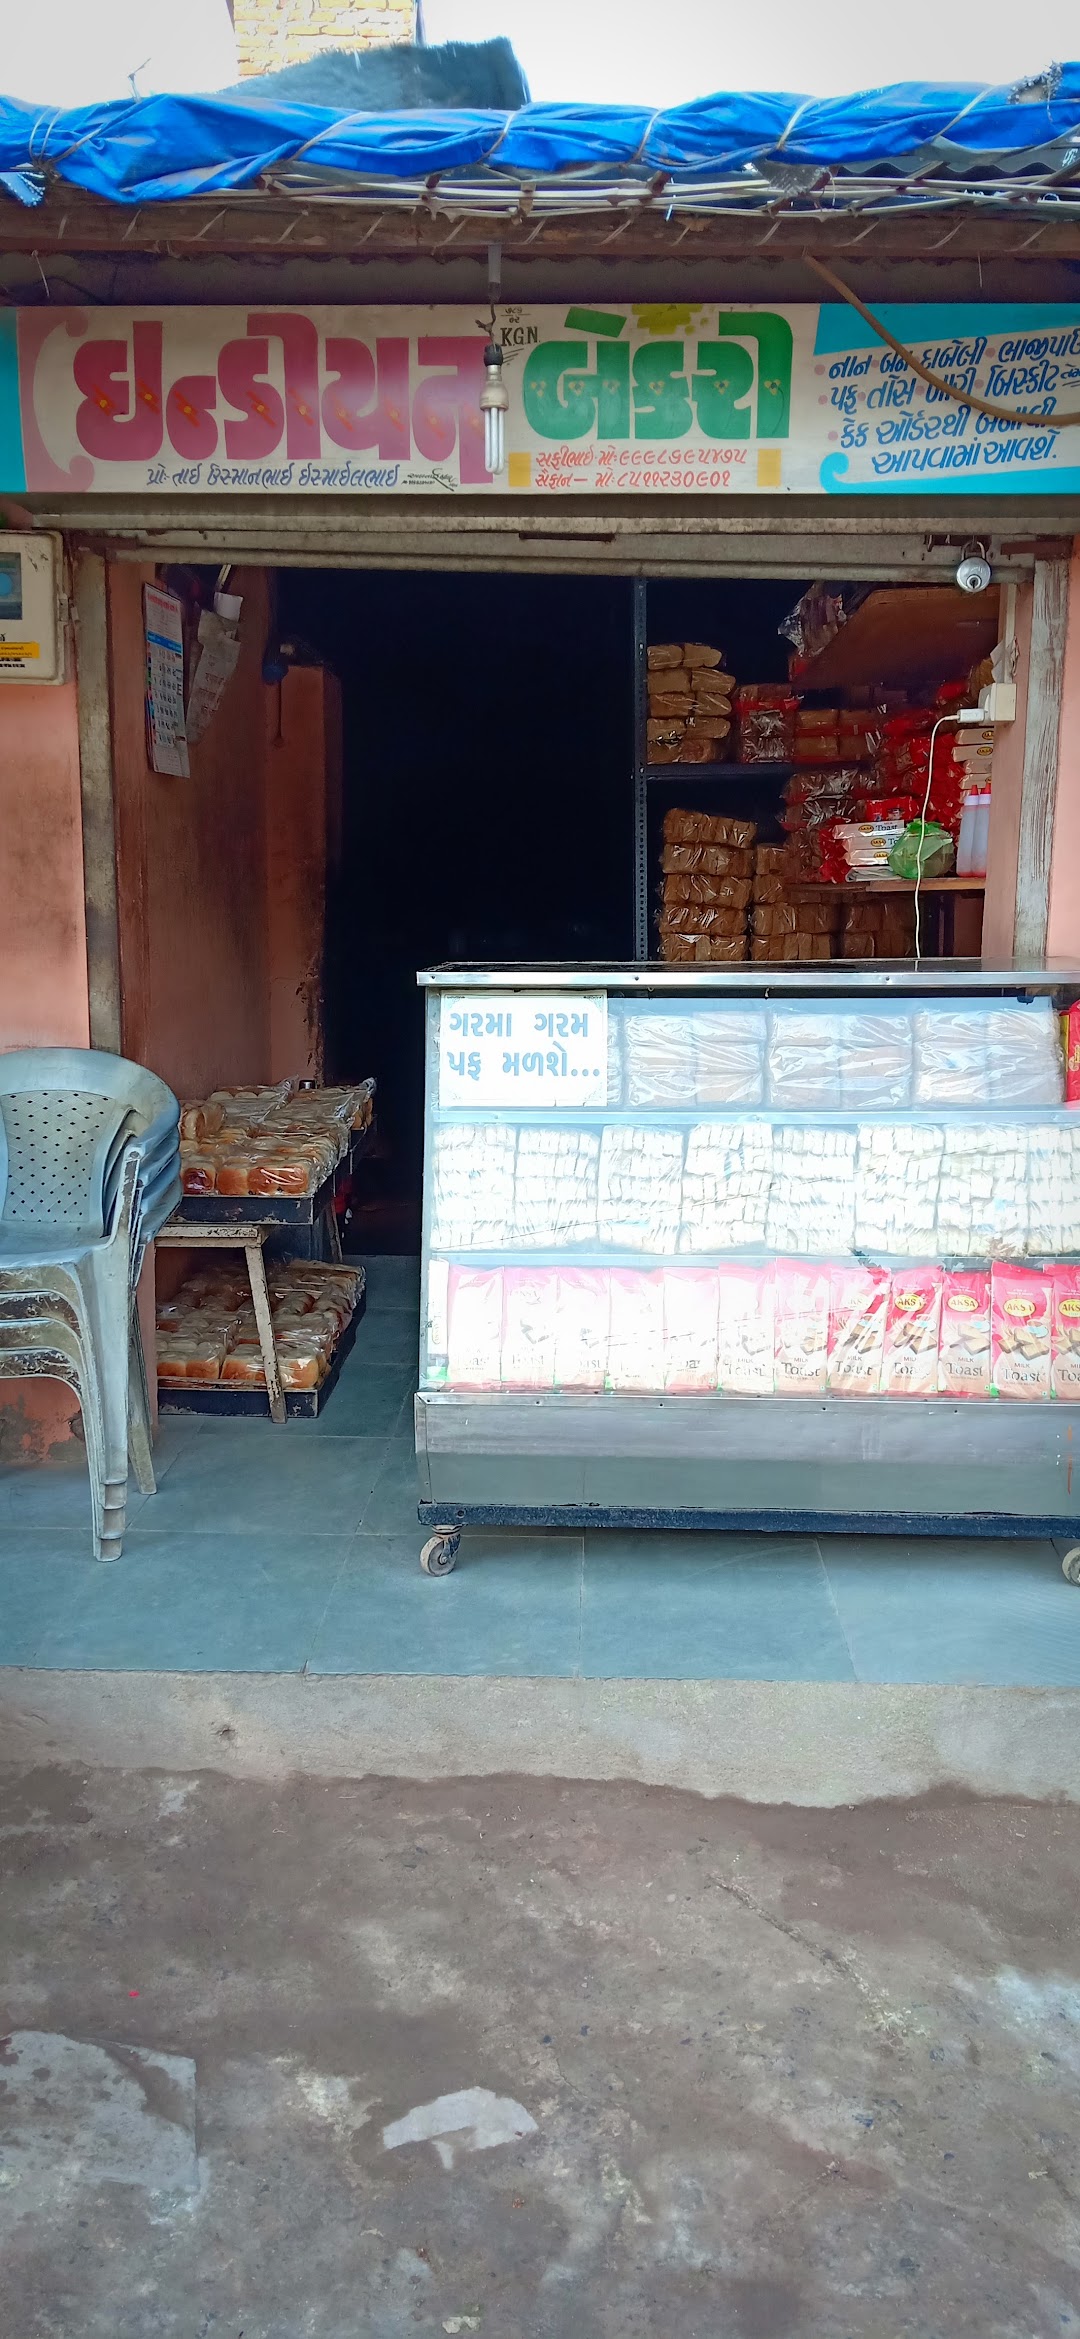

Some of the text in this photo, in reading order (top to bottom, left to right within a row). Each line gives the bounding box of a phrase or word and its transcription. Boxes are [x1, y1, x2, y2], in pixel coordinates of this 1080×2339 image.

[523, 307, 793, 439] બેકરી
[828, 354, 873, 380] નાન
[921, 336, 988, 369] દાબેલી
[831, 384, 858, 415] પફ
[984, 359, 1060, 397] બિસ્કીટ
[840, 418, 870, 448] કેક
[871, 437, 981, 475] આપવામાં
[449, 1013, 588, 1038] ગરમા ગરમ
[446, 1051, 482, 1081] પફ
[951, 1299, 976, 1307] AKSA
[894, 1363, 926, 1376] Toa
[946, 1363, 983, 1377] Toast
[1003, 1368, 1041, 1383] Toast
